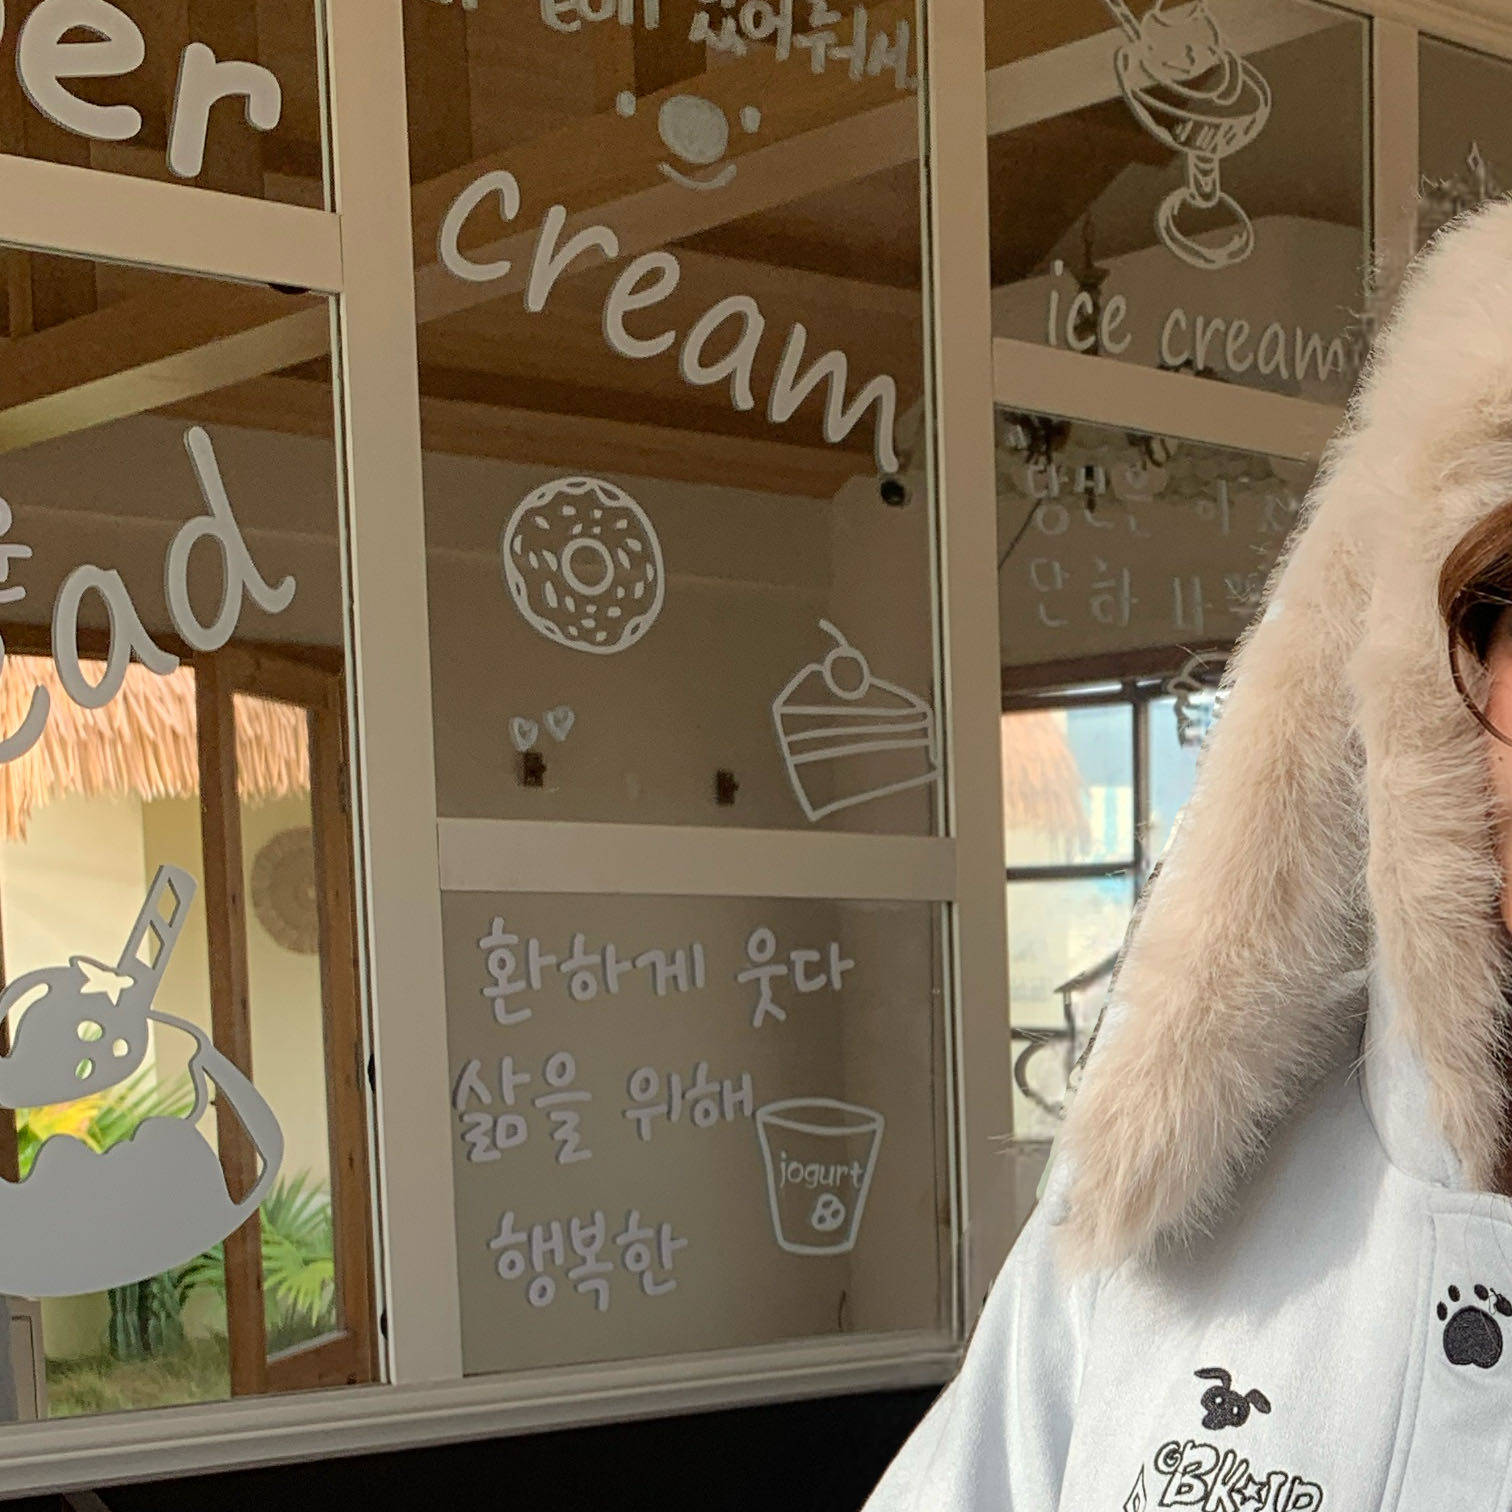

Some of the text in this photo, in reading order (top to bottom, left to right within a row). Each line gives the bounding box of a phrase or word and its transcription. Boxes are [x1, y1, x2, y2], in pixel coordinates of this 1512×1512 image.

[0, 0, 282, 178] er
[439, 170, 898, 473] cream
[1048, 259, 1344, 381] ice cream
[478, 916, 855, 1028] 환하게 웃다
[455, 1051, 755, 1164] 삶을 위해
[779, 1151, 866, 1187] jogurt
[489, 1210, 688, 1312] 행복한
